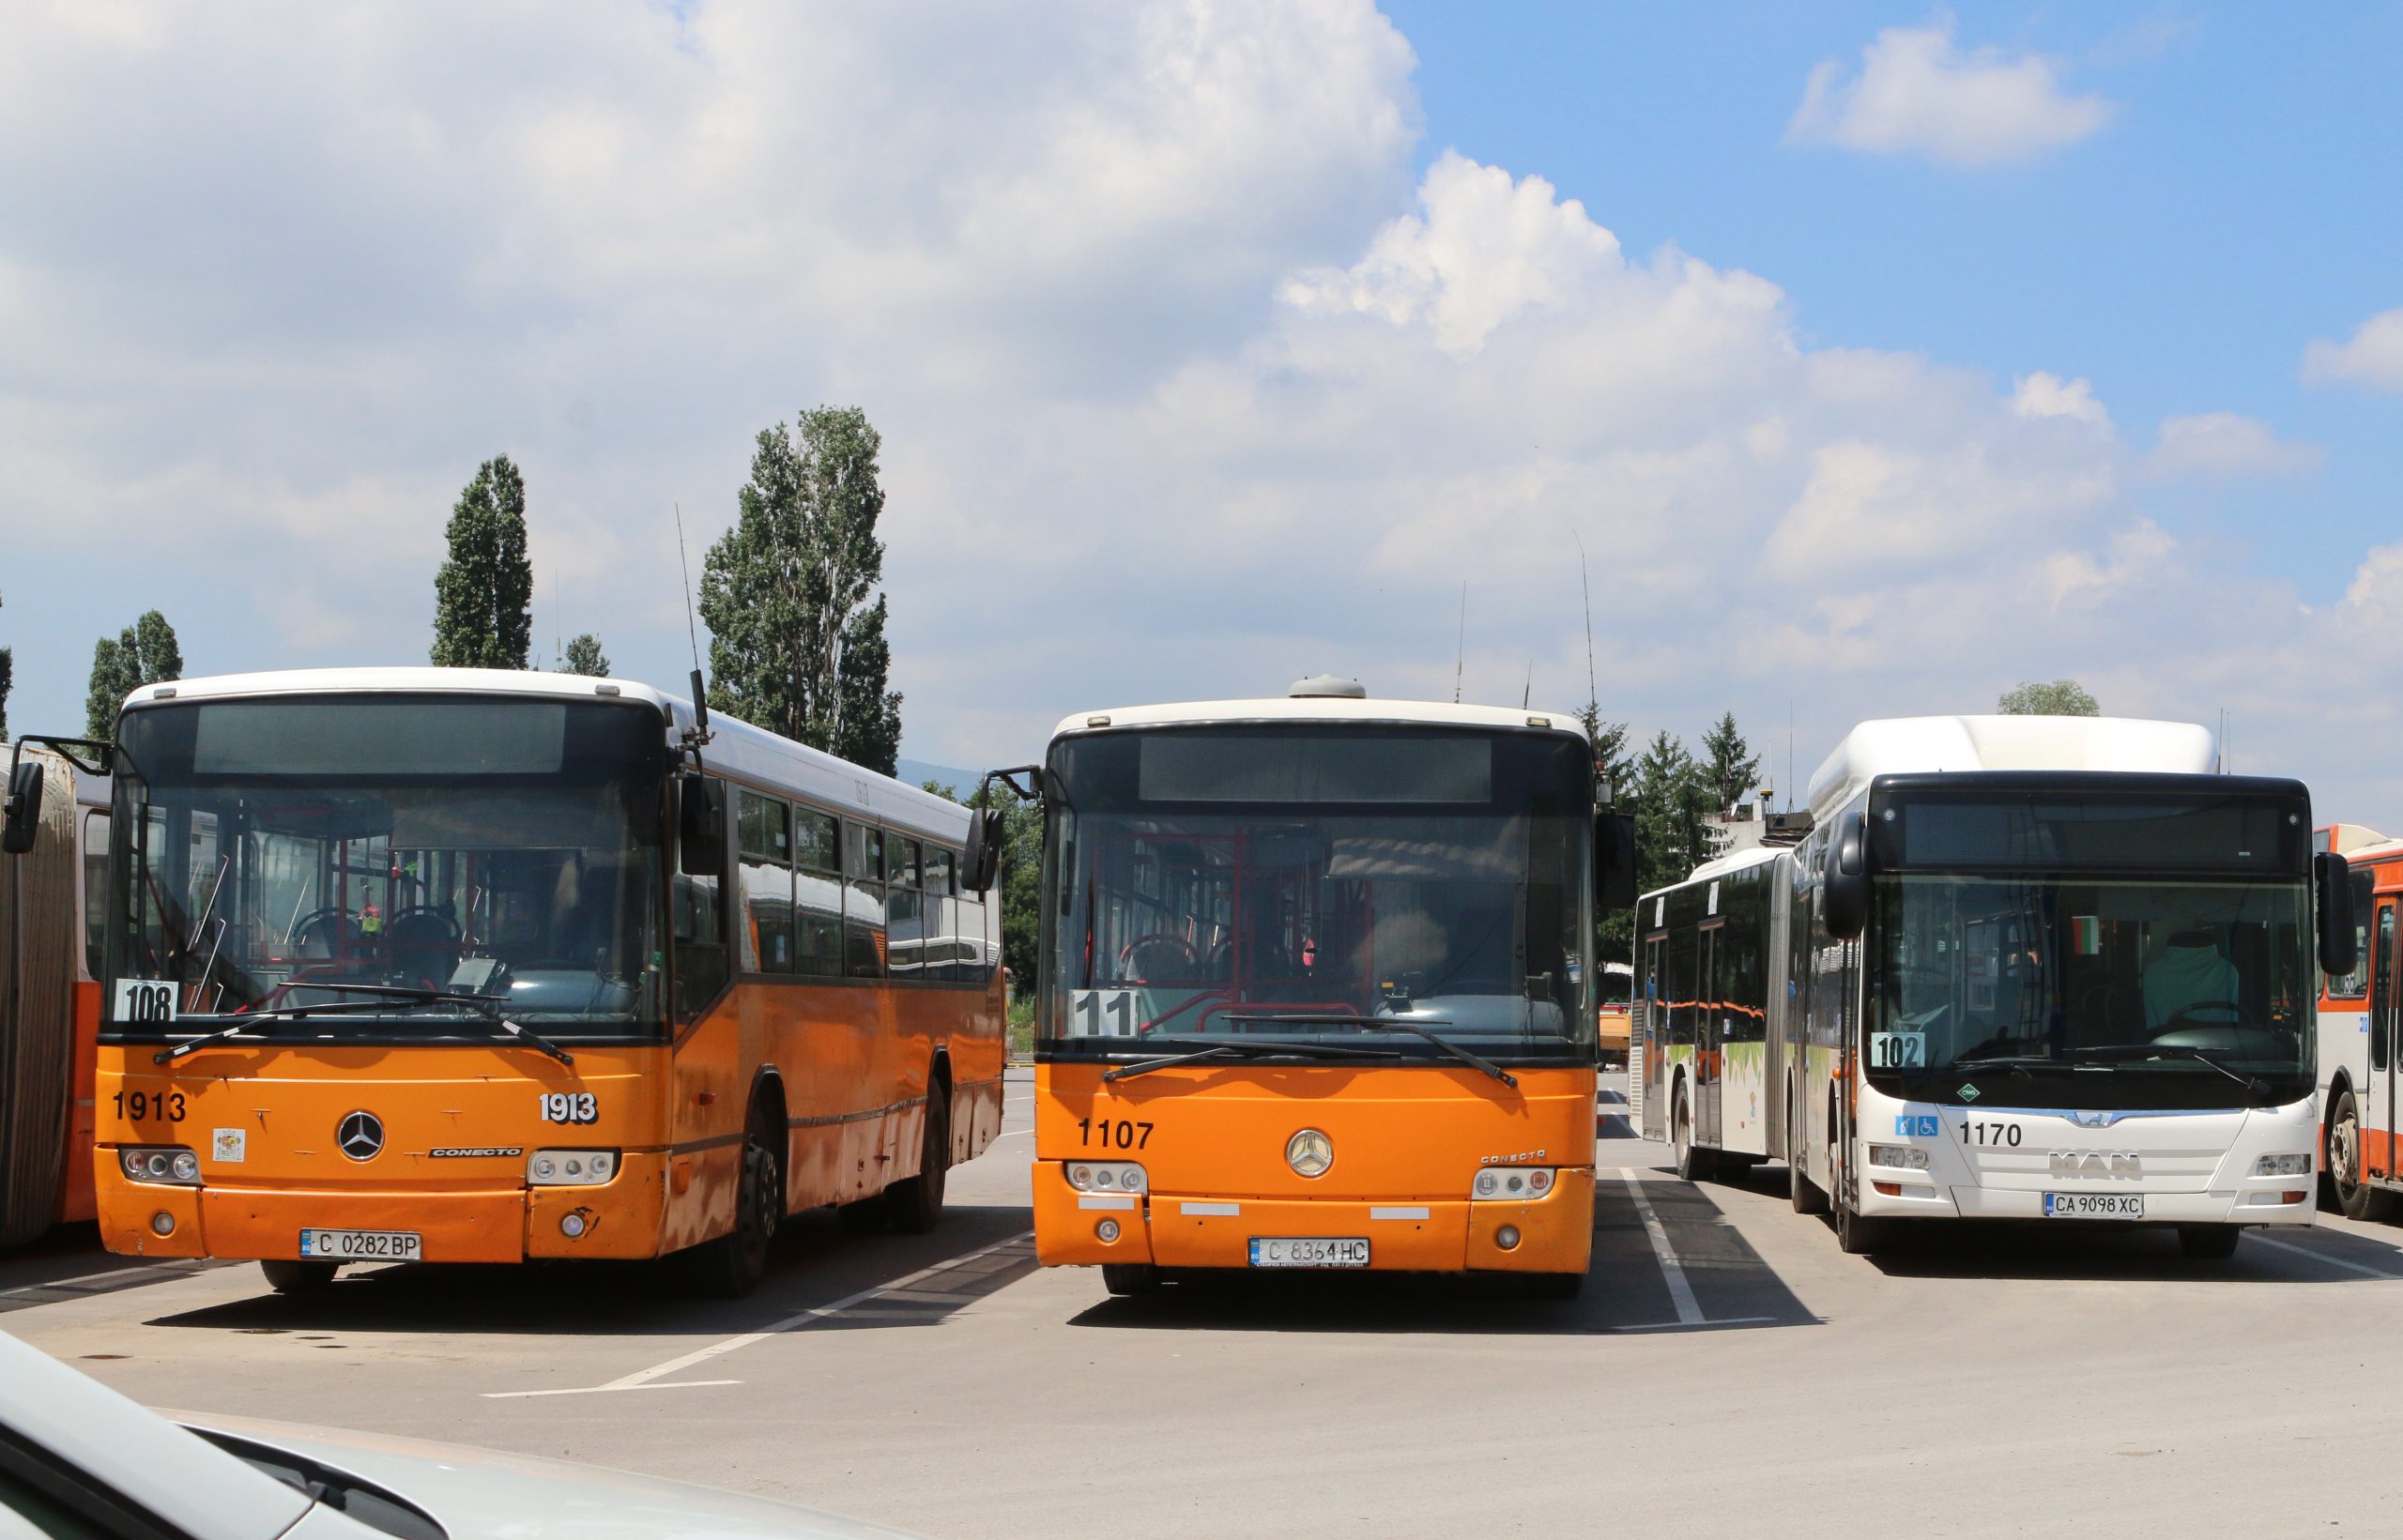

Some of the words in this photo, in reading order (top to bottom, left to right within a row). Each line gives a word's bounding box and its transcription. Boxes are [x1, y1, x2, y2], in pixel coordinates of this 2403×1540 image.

[126, 985, 172, 1021] 108
[1076, 991, 1131, 1036] 11
[1878, 1036, 1919, 1067] 102
[113, 1090, 187, 1122] 1913
[539, 1092, 598, 1124] 1913
[1079, 1118, 1154, 1150] 1107
[1959, 1121, 2022, 1147] 1170
[432, 1148, 521, 1157] CONECTO
[1480, 1150, 1546, 1164] CONECTO
[2048, 1151, 2141, 1172] MAN
[2078, 1197, 2116, 1212] 9098
[342, 1235, 388, 1254] 0282
[391, 1236, 417, 1256] BP
[1291, 1242, 1335, 1260] 8364
